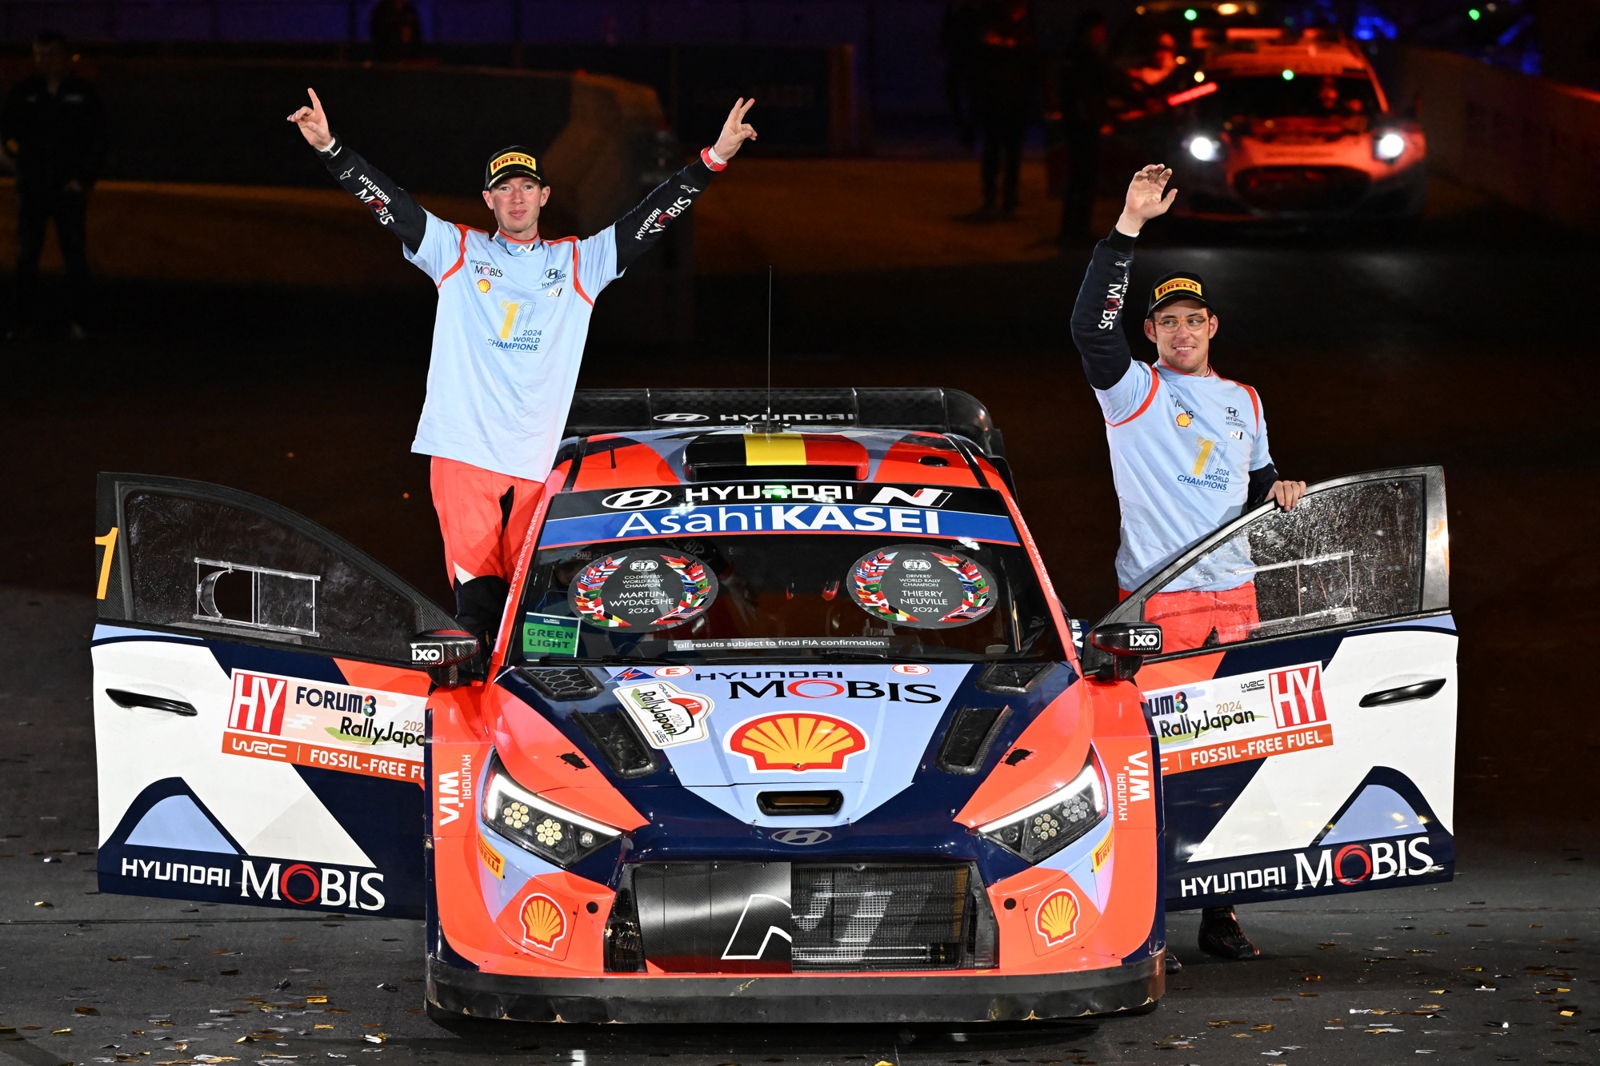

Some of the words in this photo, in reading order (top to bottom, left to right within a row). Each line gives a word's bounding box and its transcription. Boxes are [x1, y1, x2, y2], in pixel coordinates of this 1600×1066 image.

[492, 153, 533, 170] PIRELLI
[358, 174, 391, 205] HYUNDAI
[634, 207, 662, 240] HYUNDAI
[474, 265, 503, 278] MOBIS
[1158, 281, 1199, 296] PIRELLI
[720, 413, 857, 421] HYUNDAI
[1205, 474, 1230, 483] WORLD
[1215, 467, 1230, 477] 2024
[1177, 475, 1228, 491] CHAMPIONS
[685, 485, 854, 502] HYUNDAI
[94, 527, 118, 600] 1
[631, 561, 658, 571] FIA
[904, 561, 930, 570] FIA
[609, 598, 674, 607] WYDAEGHE
[900, 597, 948, 606] NEUVILLE
[527, 628, 574, 640] GREEN
[1129, 629, 1158, 647] ixo
[411, 643, 440, 661] ixo
[529, 639, 571, 648] LIGHT
[727, 640, 764, 649] subject
[778, 639, 801, 647] final
[820, 639, 885, 647] confirmation
[695, 671, 843, 681] HYUNDAI
[903, 666, 918, 674] E
[729, 679, 942, 704] MOBIS
[1240, 679, 1265, 689] WRC
[230, 675, 285, 733] HY
[296, 686, 376, 717] FORUM8
[1271, 667, 1317, 728] HY
[1216, 700, 1242, 715] 2024
[340, 716, 425, 748] RallyJapa
[232, 737, 287, 757] WRC
[1191, 736, 1284, 766] FOSSIL-FREE
[1287, 730, 1323, 749] FUEL
[310, 749, 407, 777] FOSSIL-FREE
[461, 754, 472, 800] HYUNDAI
[1116, 773, 1128, 821] HYUNDAI
[1180, 866, 1286, 898] HYUNDAI
[1293, 836, 1434, 890] MOBIS
[121, 857, 231, 888] HYUNDAI
[240, 859, 386, 911] MOBIS
